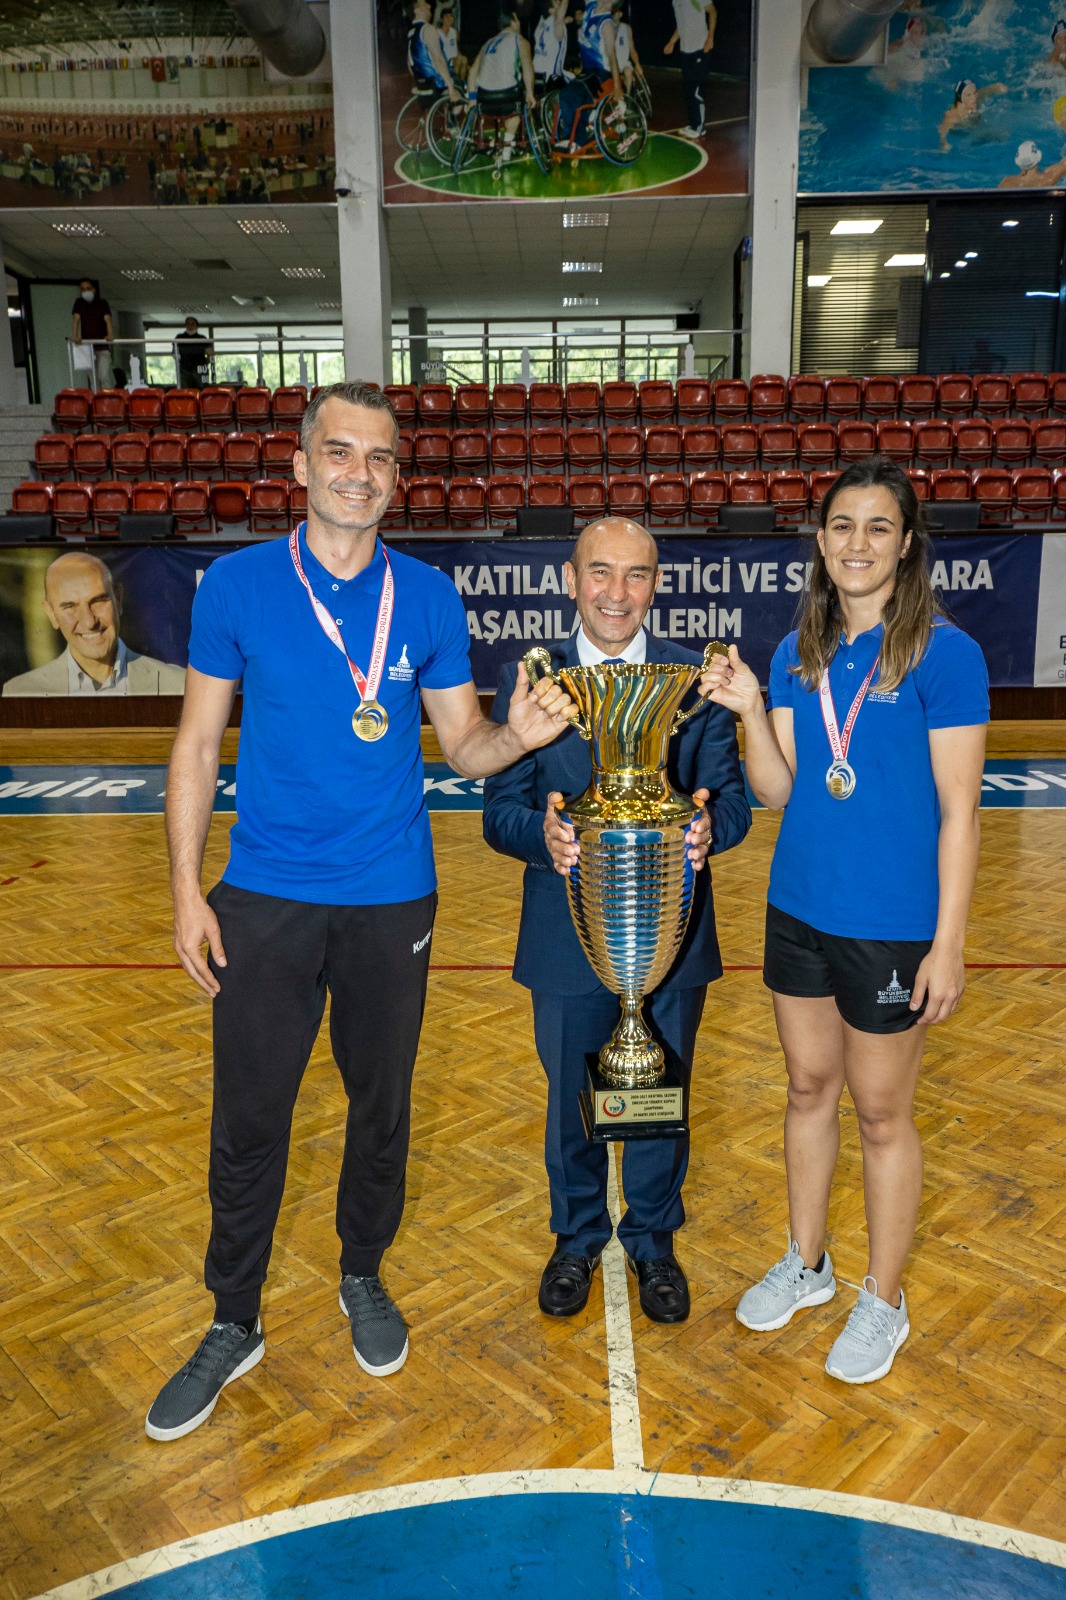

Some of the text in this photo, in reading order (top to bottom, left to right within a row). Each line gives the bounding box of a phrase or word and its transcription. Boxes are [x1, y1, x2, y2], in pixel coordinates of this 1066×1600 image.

[656, 556, 730, 594] ETİCİ
[738, 562, 778, 592] VE
[377, 602, 390, 634] HENTBOL
[466, 602, 742, 645] AŞARIL LERİM
[369, 636, 384, 691] FEDERASYONU
[828, 723, 839, 754] TÜRKİYE
